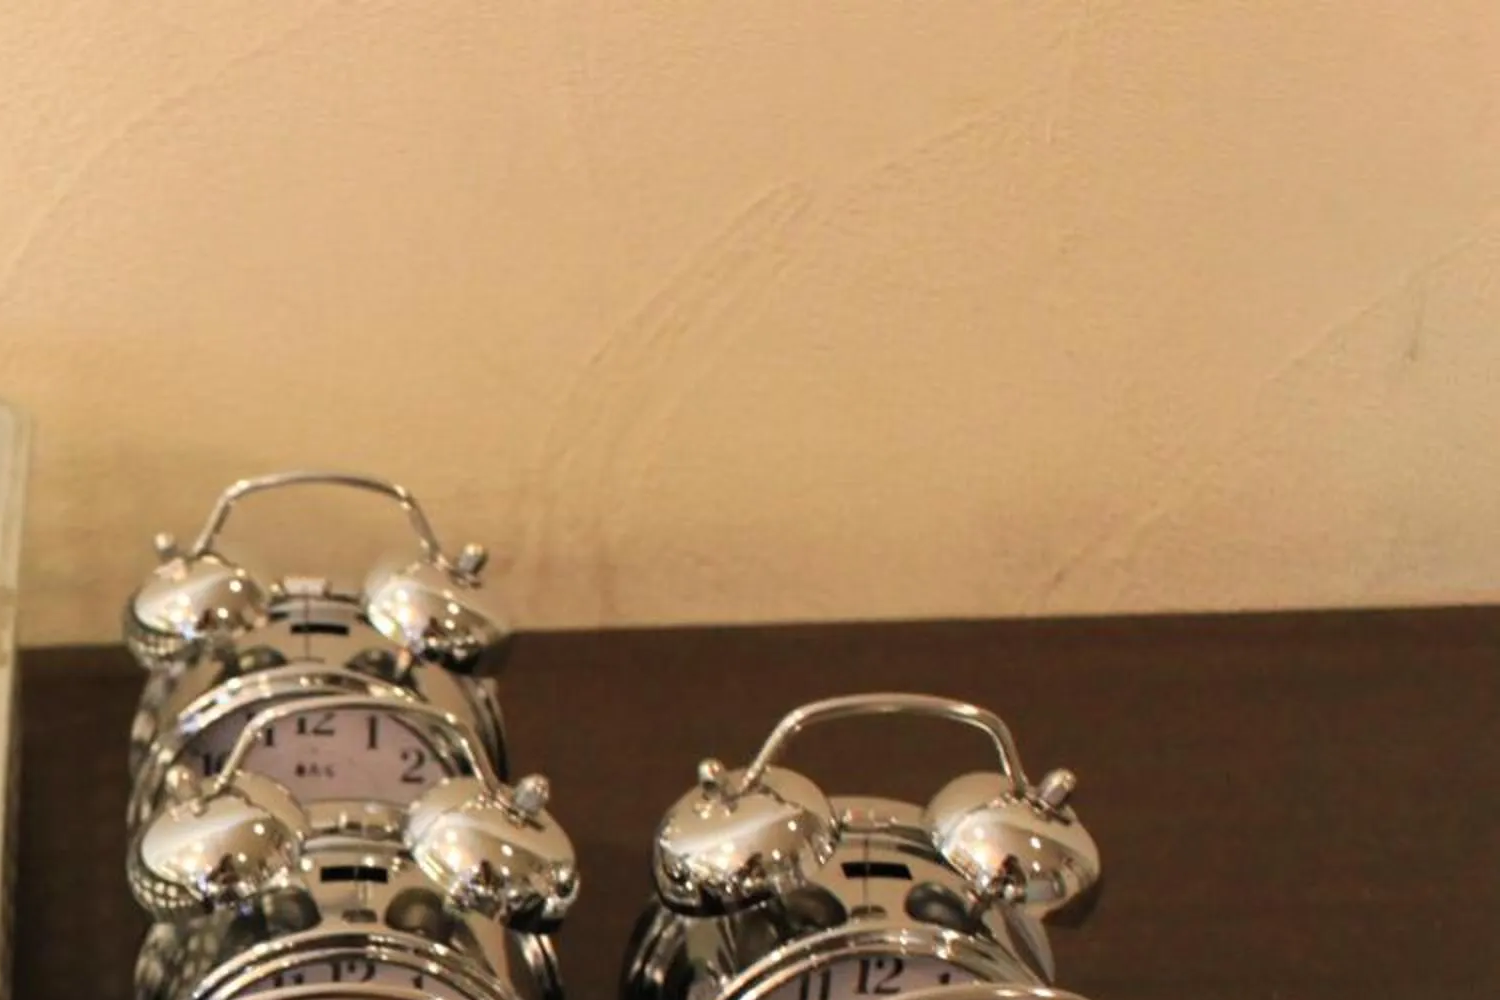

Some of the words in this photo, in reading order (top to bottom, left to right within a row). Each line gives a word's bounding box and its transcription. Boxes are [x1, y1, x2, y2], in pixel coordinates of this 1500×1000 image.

[366, 715, 379, 749] 1
[401, 751, 426, 784] 2
[855, 957, 904, 995] 12
